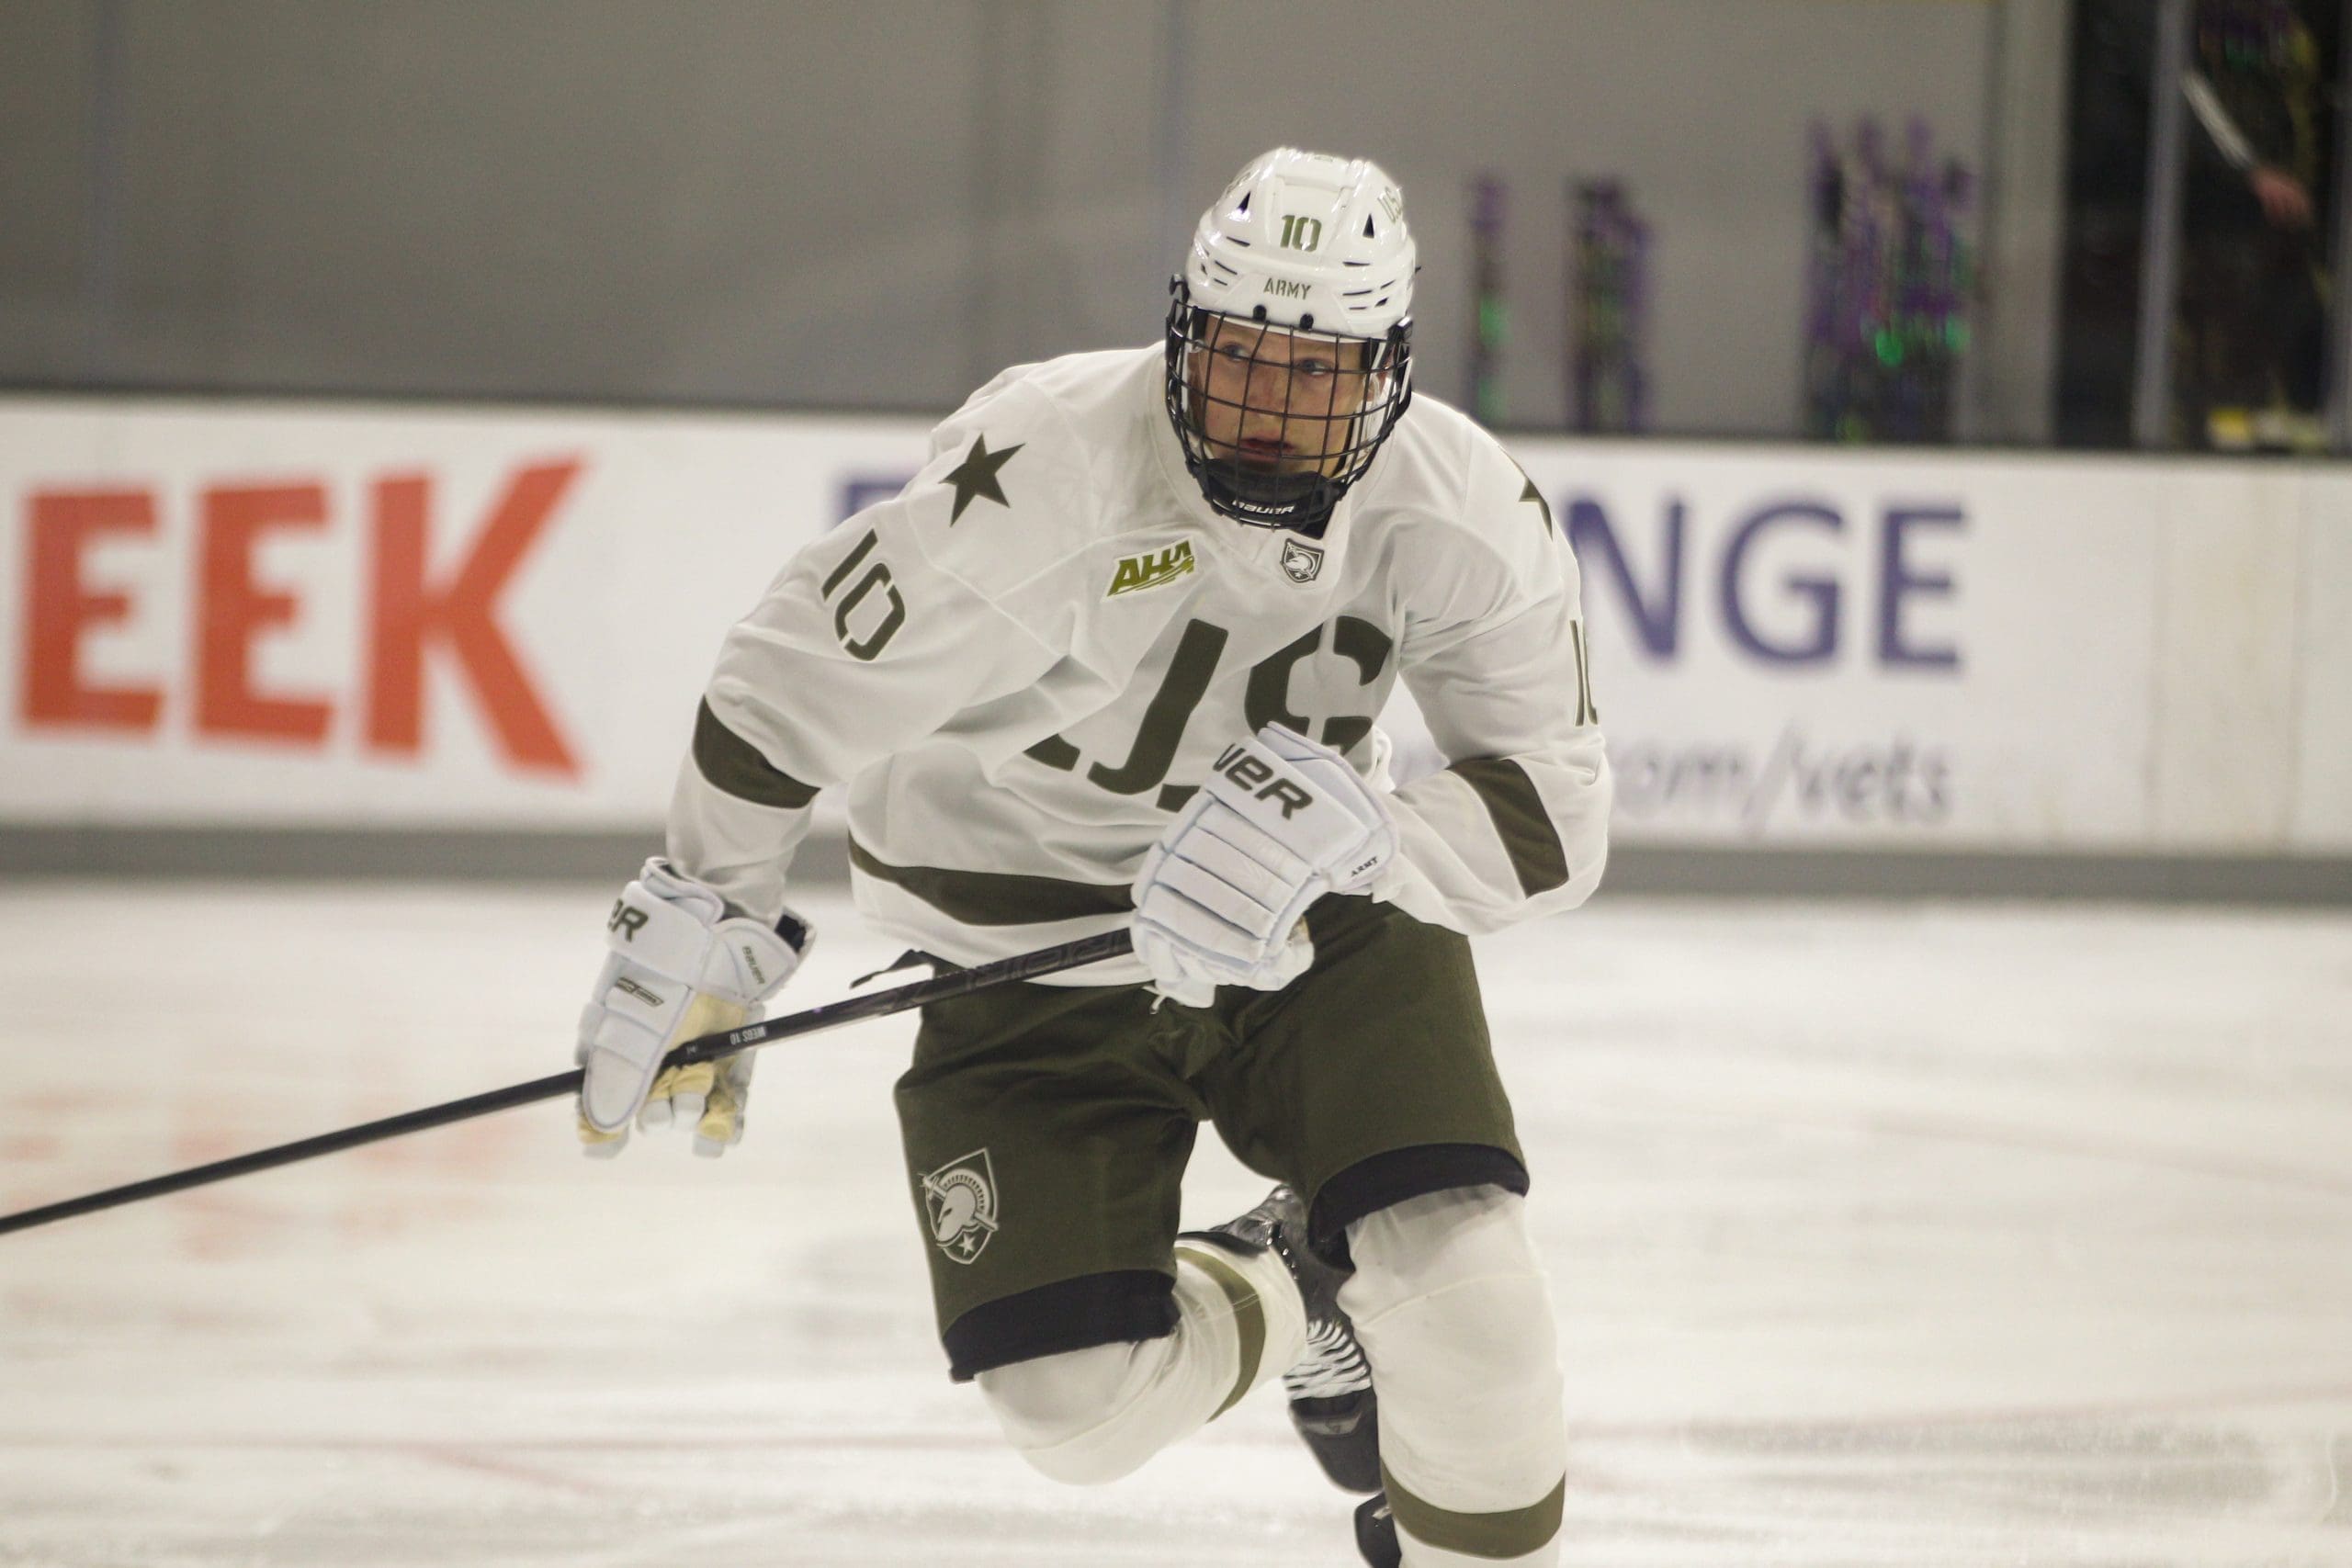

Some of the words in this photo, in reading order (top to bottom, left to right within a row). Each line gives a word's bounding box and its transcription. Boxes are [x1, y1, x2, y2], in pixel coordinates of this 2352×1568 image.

[1280, 214, 1322, 253] 10
[1263, 277, 1312, 301] ARMY
[22, 452, 588, 781] EEK
[820, 527, 906, 661] 10
[1569, 619, 1599, 728] 1
